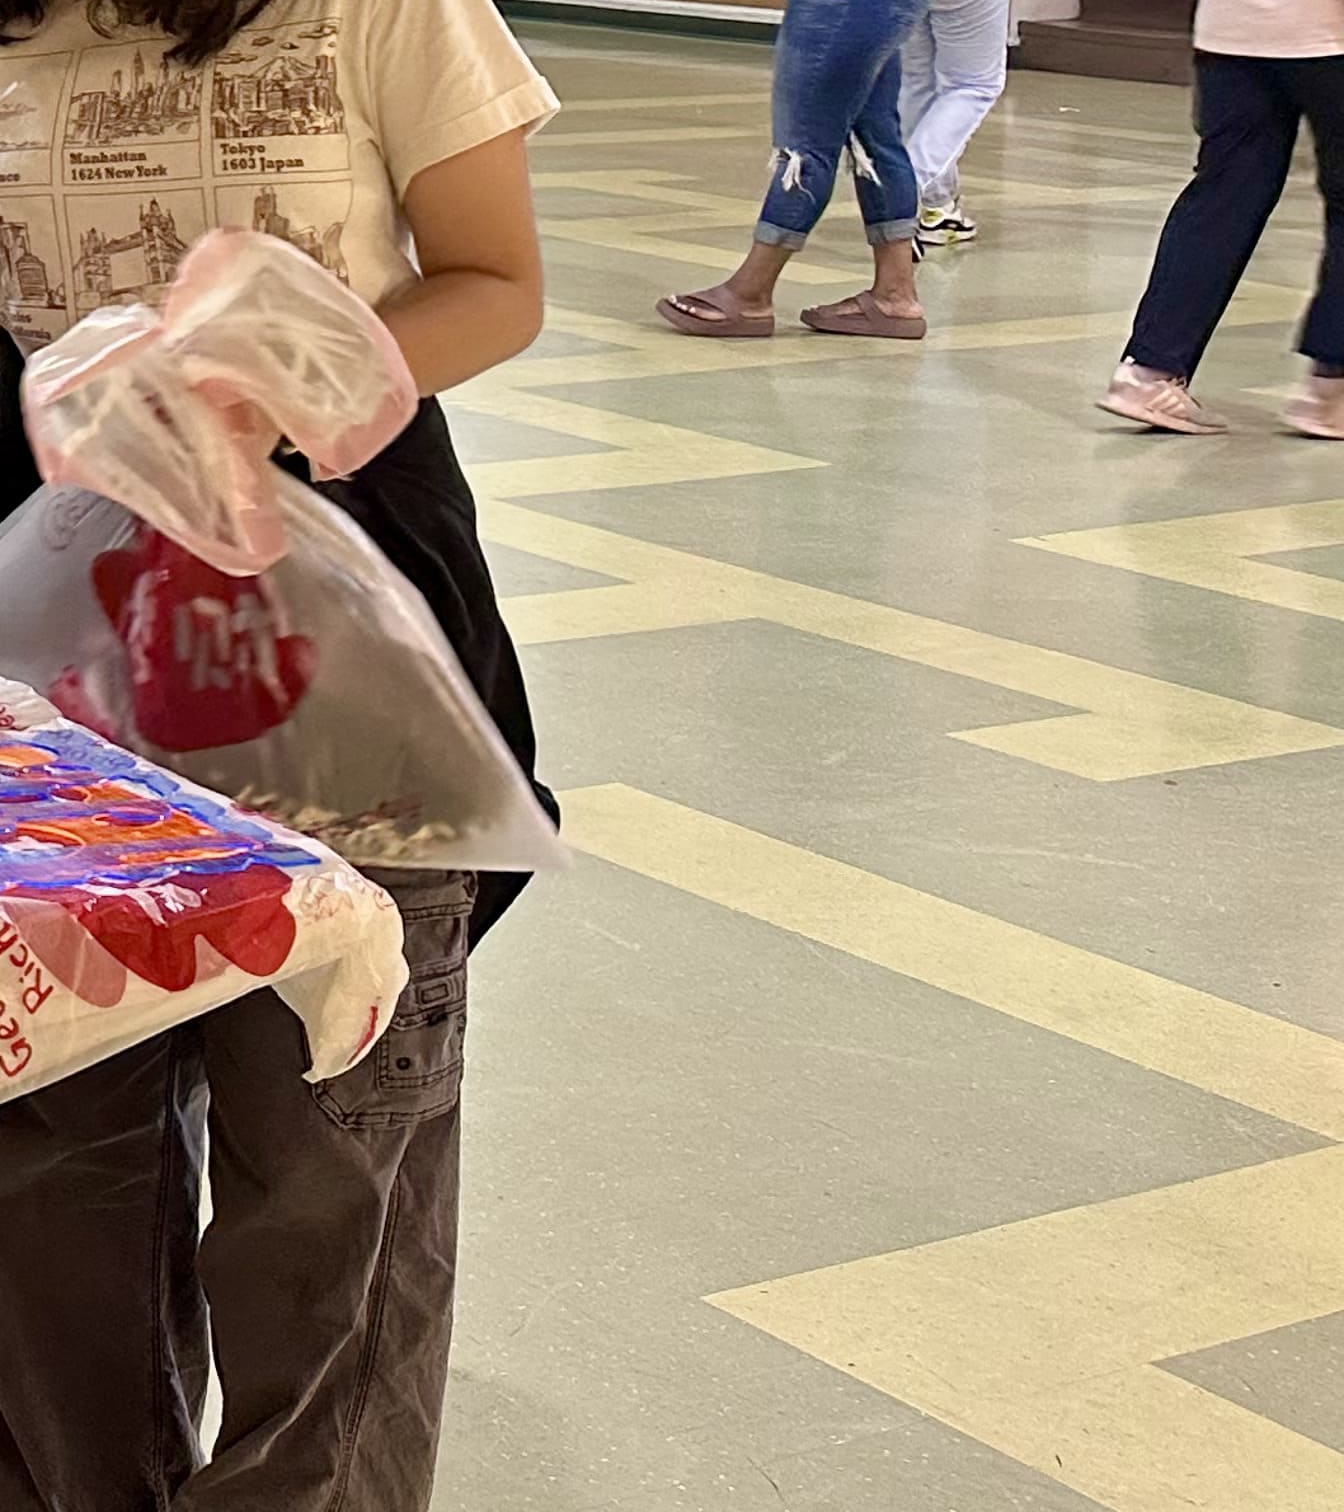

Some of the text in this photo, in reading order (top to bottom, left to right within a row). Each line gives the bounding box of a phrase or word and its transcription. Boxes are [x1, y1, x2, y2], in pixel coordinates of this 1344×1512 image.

[220, 143, 266, 156] Tokyo
[69, 152, 148, 165] Manhattan
[222, 157, 304, 172] 1603 Japan
[71, 164, 169, 181] 1624 New York
